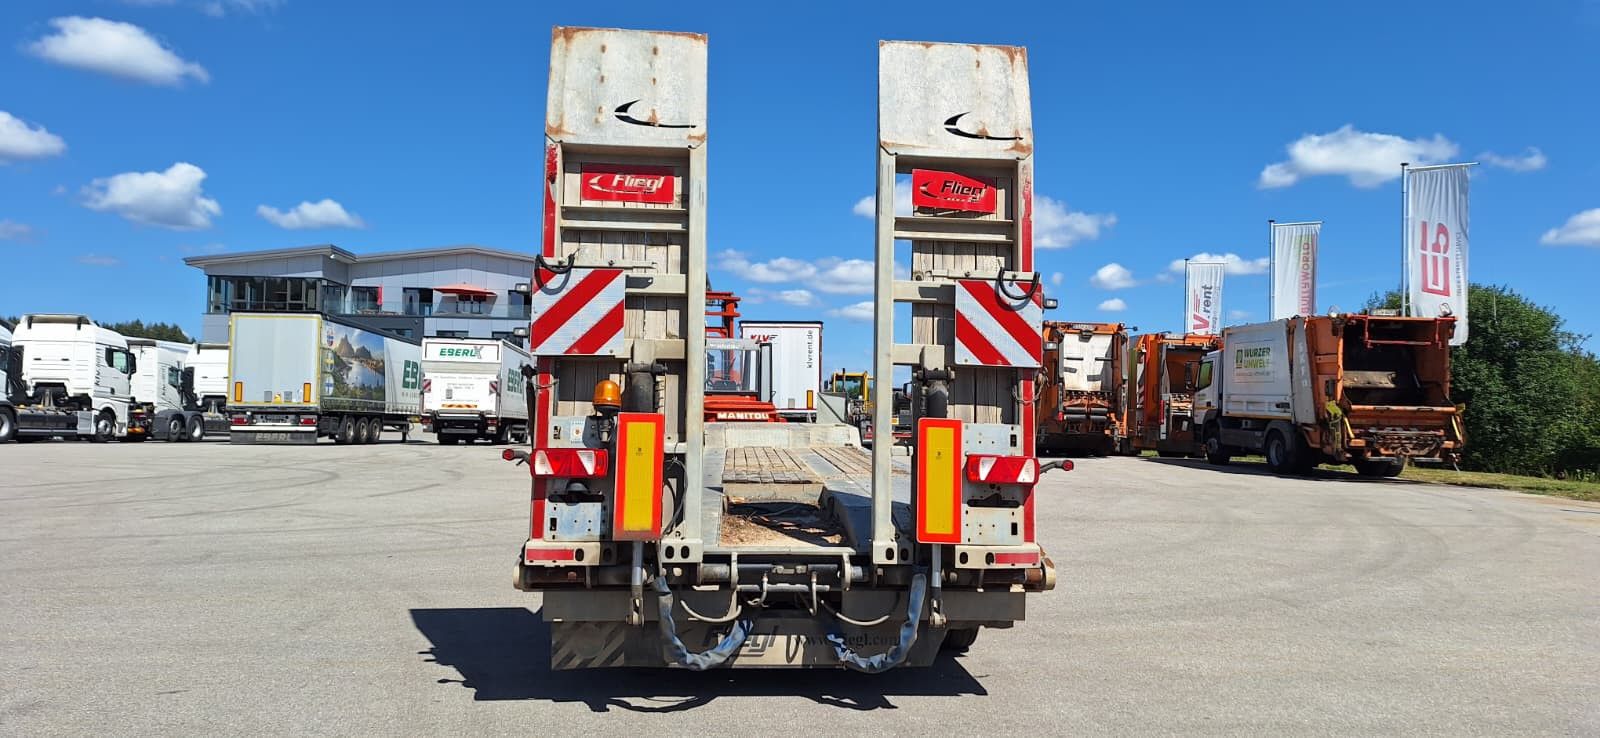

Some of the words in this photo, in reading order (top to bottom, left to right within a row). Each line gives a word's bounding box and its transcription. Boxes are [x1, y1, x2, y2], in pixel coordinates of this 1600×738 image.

[611, 174, 665, 194] Fliegl
[439, 347, 477, 357] EBERL
[402, 360, 421, 390] EB
[717, 412, 769, 420] MANITOU
